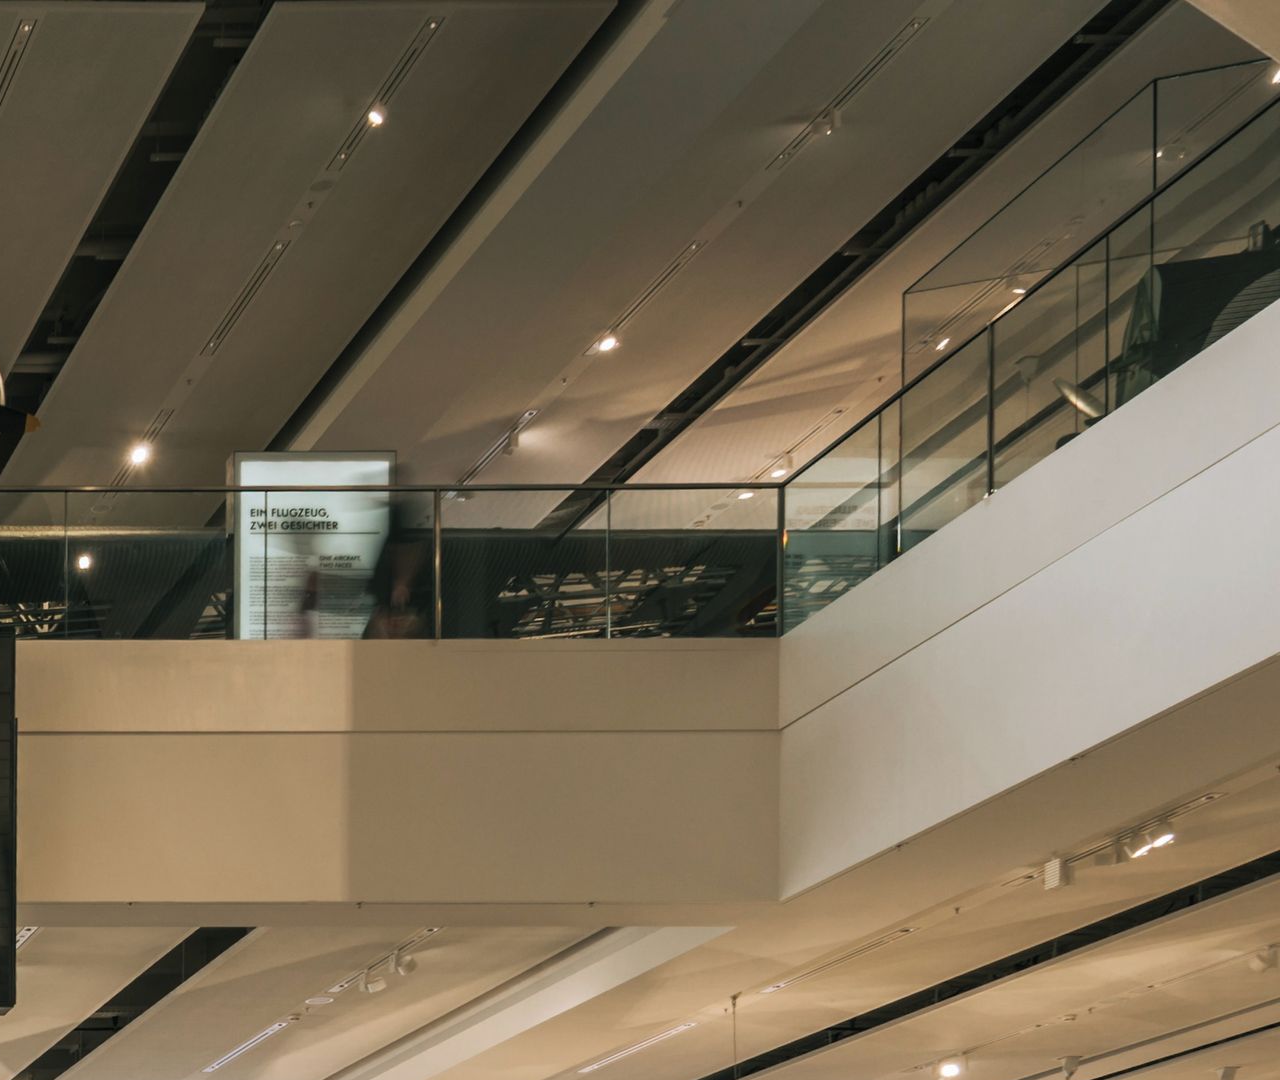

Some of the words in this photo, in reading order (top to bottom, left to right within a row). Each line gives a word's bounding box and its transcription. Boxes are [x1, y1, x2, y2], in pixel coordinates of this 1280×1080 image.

[250, 508, 268, 518] EIN
[271, 508, 329, 519] FLUGZEUG,
[250, 520, 278, 530] ZWEI
[280, 520, 338, 530] GESICHTER
